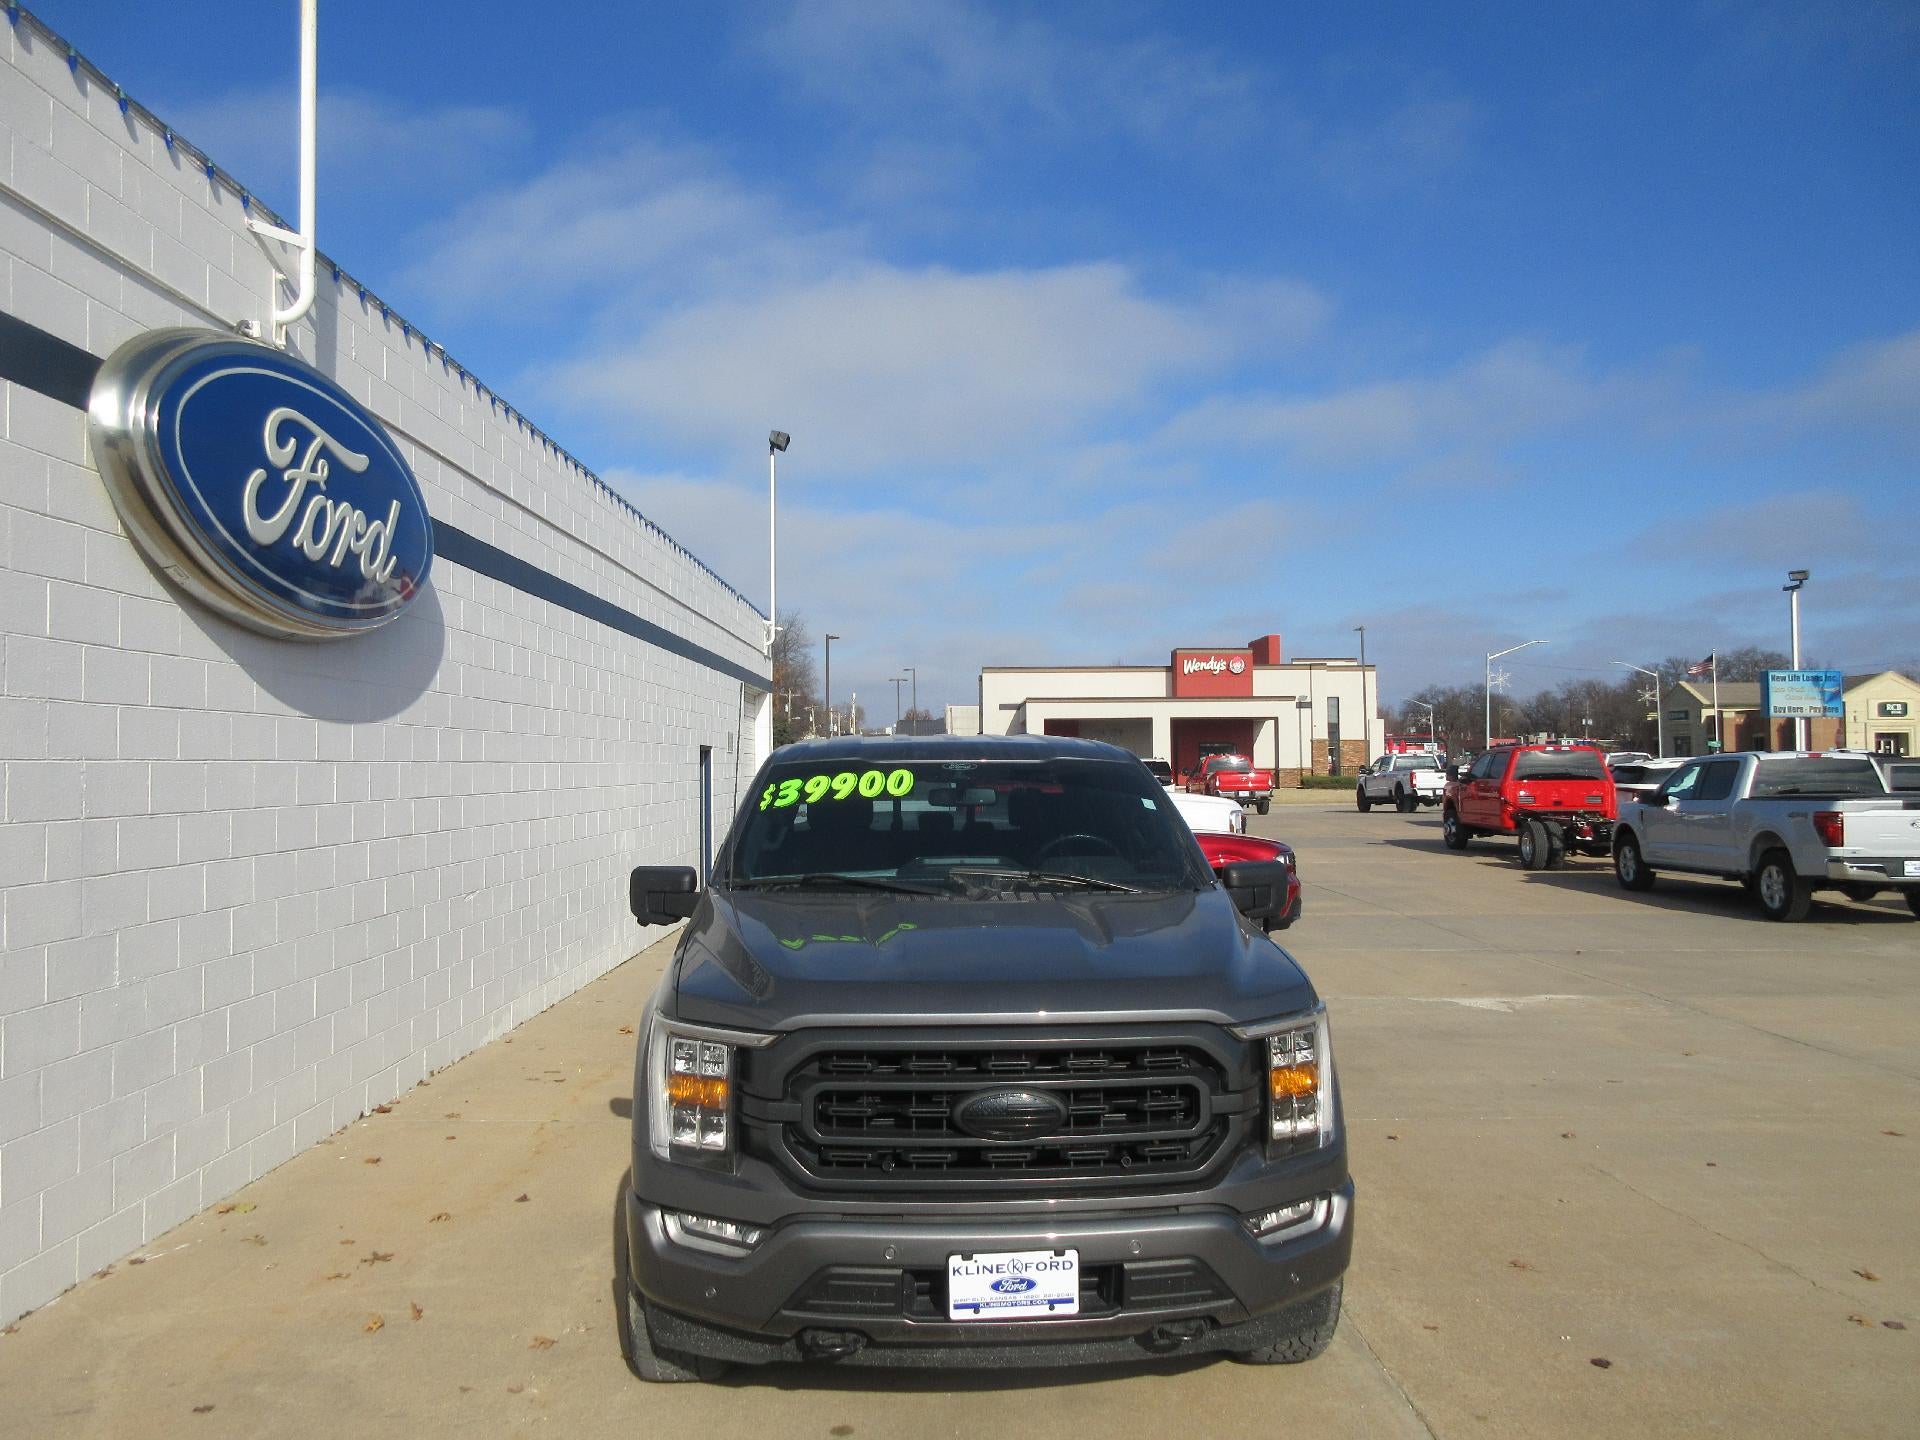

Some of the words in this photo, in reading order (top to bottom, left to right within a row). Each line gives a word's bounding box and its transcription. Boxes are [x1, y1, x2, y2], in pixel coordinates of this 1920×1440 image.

[243, 407, 401, 584] Ford
[1183, 655, 1227, 675] Wendy's
[1770, 673, 1787, 682] New
[1788, 673, 1800, 682] Life
[1802, 673, 1823, 682] Loans
[1773, 705, 1786, 714] Buy
[1787, 705, 1804, 714] Here
[1809, 705, 1822, 714] Pay
[1822, 705, 1840, 714] Here
[1886, 703, 1902, 711] RCB
[760, 769, 914, 812] $39900
[952, 1264, 1006, 1277] KLINE
[1025, 1260, 1073, 1272] FORD
[998, 1277, 1028, 1292] Ford
